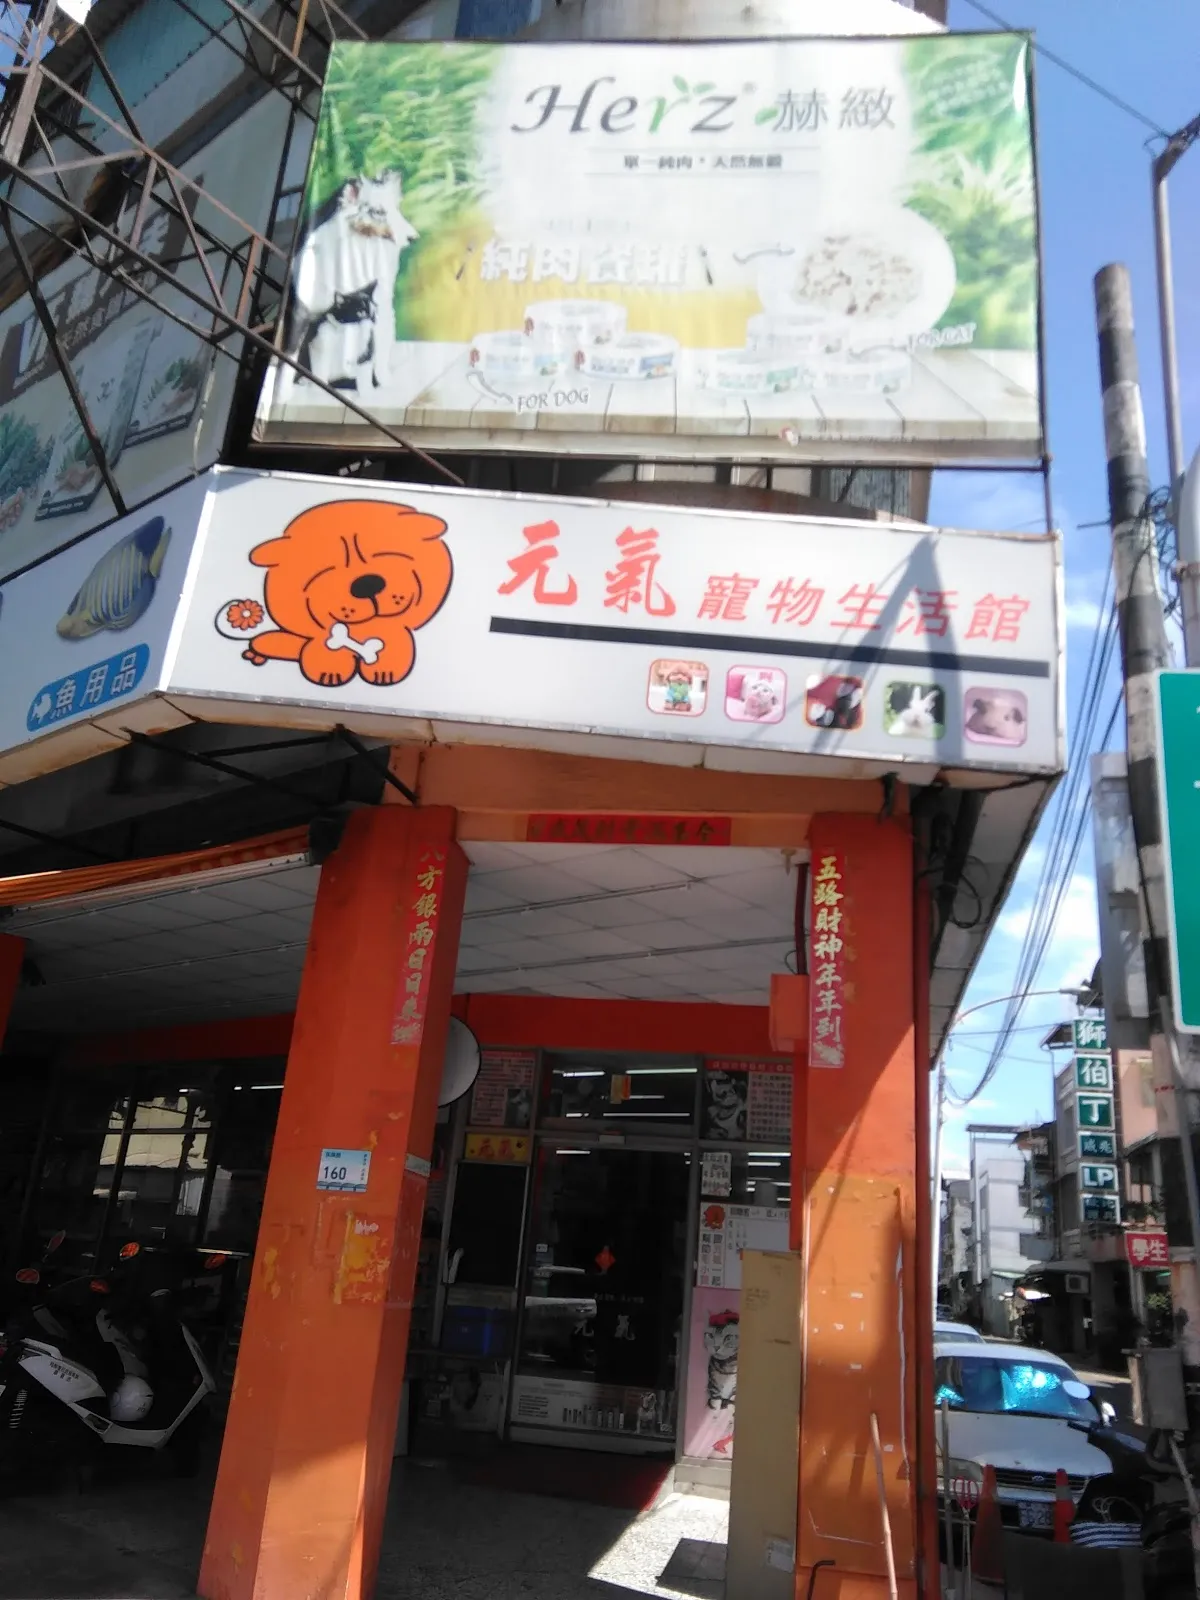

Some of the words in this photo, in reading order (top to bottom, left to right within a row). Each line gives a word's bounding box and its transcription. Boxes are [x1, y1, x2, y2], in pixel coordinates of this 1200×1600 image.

[511, 76, 738, 134] Herz
[771, 86, 897, 132] 赫緻
[516, 391, 549, 413] FOR
[553, 388, 590, 408] DOG
[497, 519, 677, 618] 元氣
[695, 572, 1031, 645] 寵物生活館
[50, 651, 137, 719] 魚用品
[813, 855, 844, 1043] 五路財神年年到
[1076, 1020, 1109, 1124] 獅伯丁
[323, 1166, 347, 1181] 160
[1083, 1167, 1114, 1187] LP
